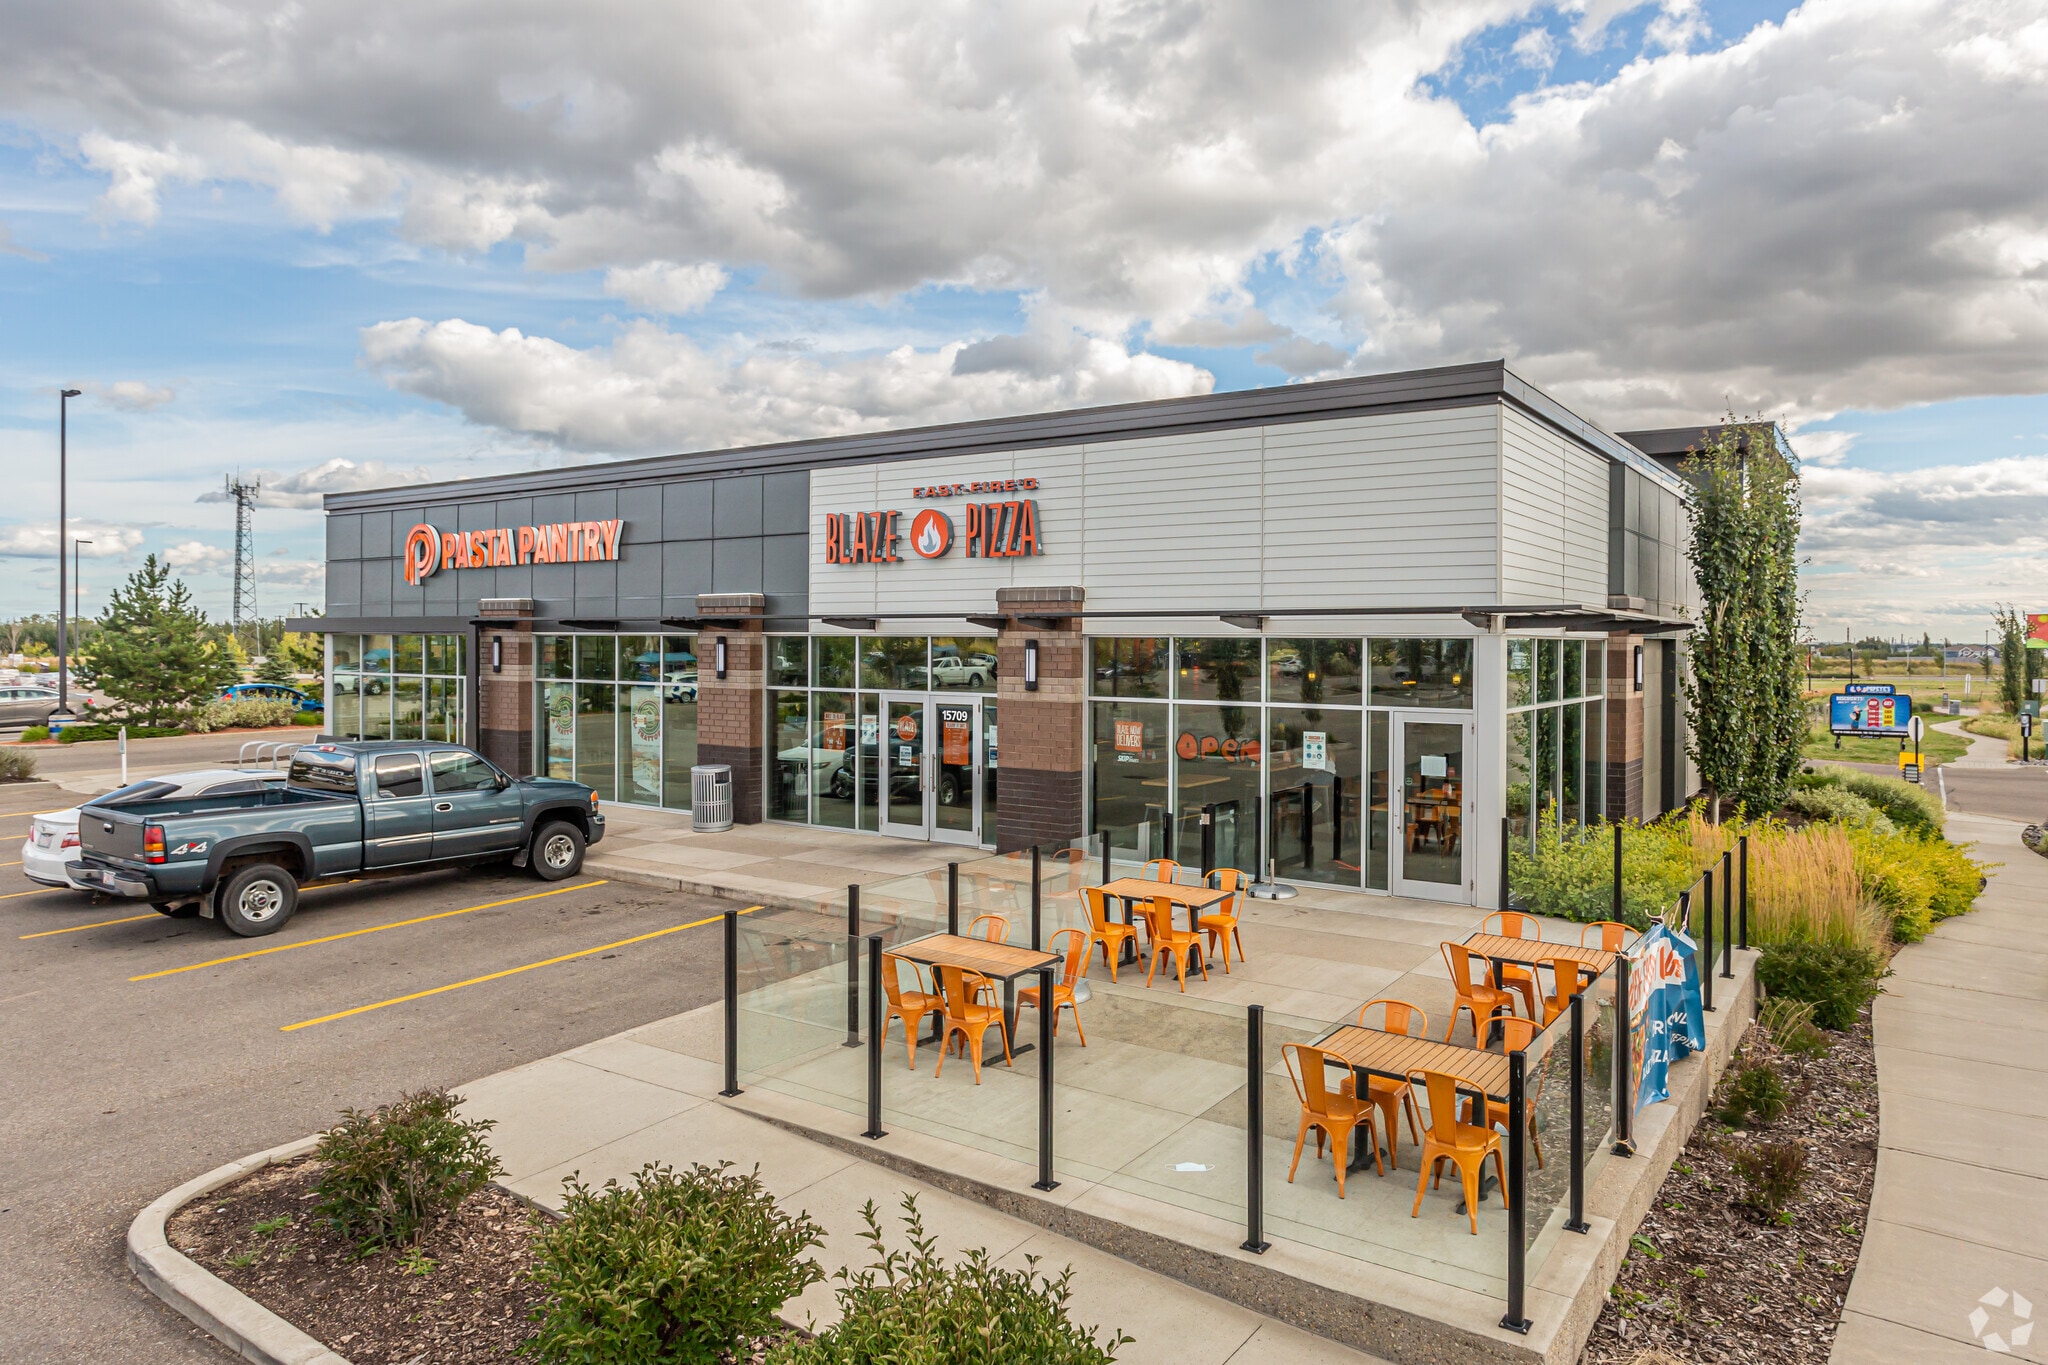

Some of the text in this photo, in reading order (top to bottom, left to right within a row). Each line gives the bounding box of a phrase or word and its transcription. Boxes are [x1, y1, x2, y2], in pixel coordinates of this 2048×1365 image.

[442, 528, 515, 569] PASTA
[518, 520, 622, 564] PANTRY
[826, 500, 1042, 564] BLAZE PIZZA
[942, 710, 968, 721] 15709
[1116, 734, 1141, 747] DELIVERS
